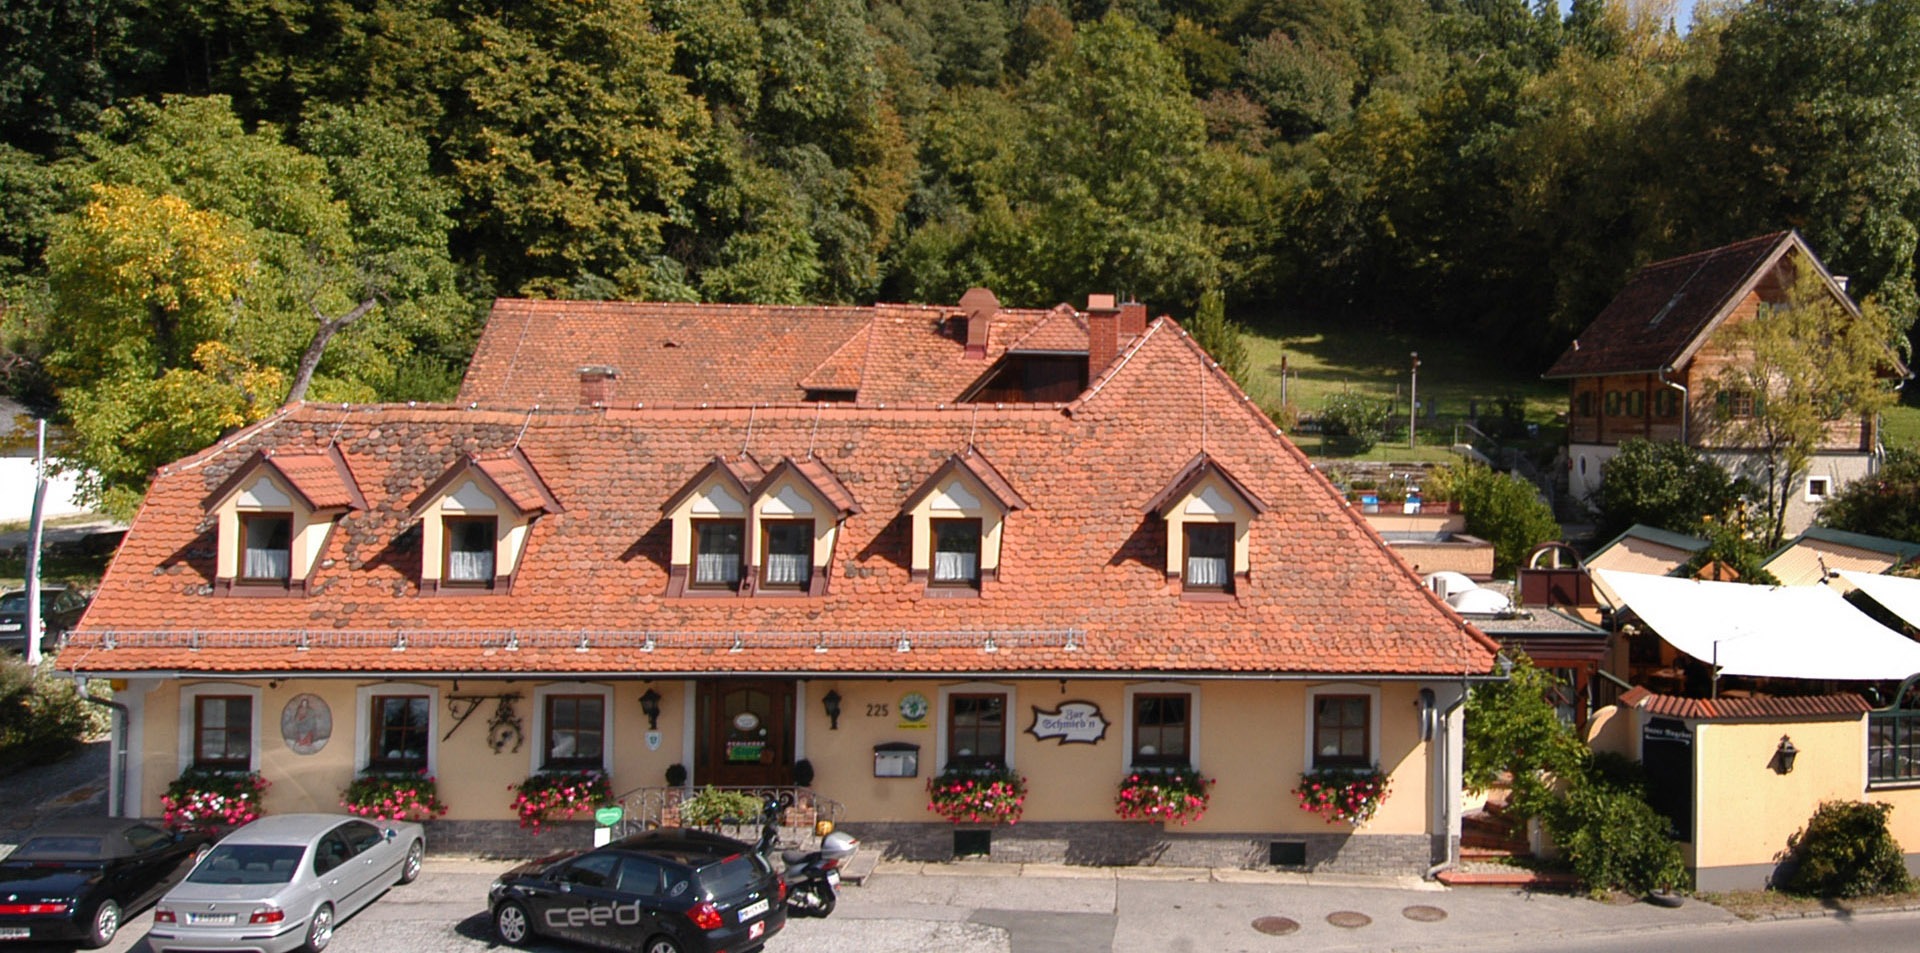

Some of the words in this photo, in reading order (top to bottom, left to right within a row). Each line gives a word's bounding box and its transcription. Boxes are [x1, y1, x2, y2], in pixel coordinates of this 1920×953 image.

[866, 704, 889, 717] 225
[1065, 709, 1084, 721] Zur
[545, 900, 640, 927] cee'd
